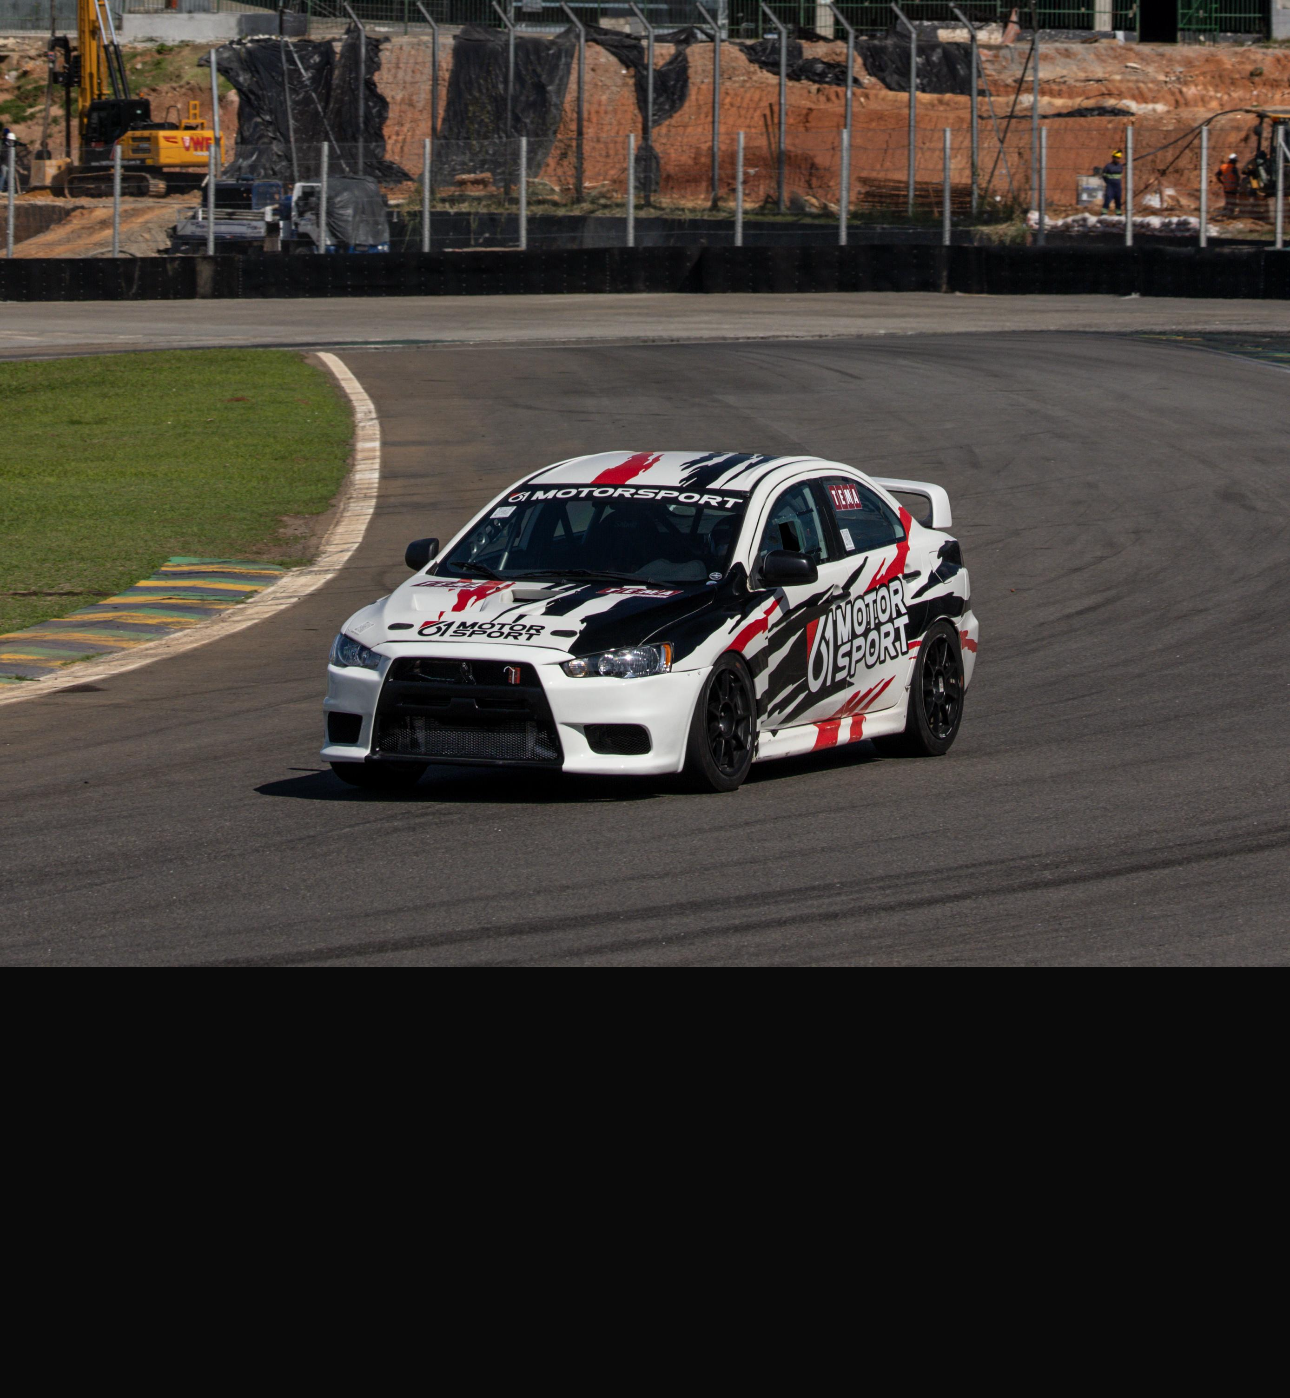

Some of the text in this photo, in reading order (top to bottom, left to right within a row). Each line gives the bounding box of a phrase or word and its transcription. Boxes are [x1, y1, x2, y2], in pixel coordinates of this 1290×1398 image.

[531, 488, 743, 509] MOTORSPORT
[831, 488, 860, 506] TEMA
[835, 579, 908, 647] MOTOR
[449, 629, 542, 641] SPORT
[455, 621, 546, 634] MOTOR
[835, 614, 909, 682] SPORT
